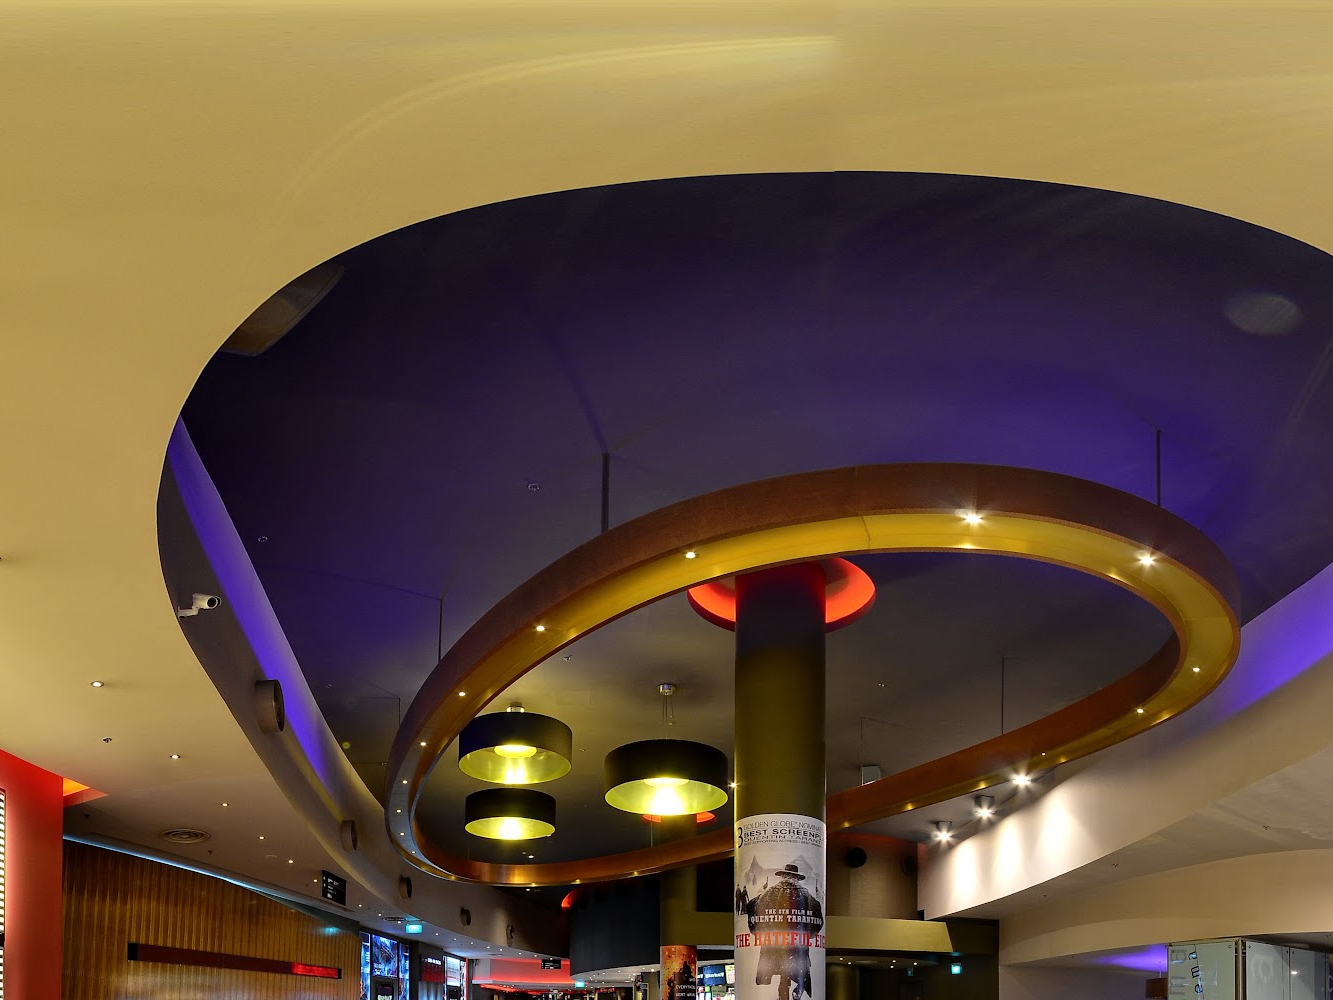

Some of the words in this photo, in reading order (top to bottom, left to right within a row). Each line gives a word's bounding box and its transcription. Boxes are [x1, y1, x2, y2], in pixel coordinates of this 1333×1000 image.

[751, 915, 783, 924] QUENTIN
[787, 916, 823, 925] TARANTINO
[736, 934, 751, 948] THE
[754, 932, 812, 947] HATEFUL
